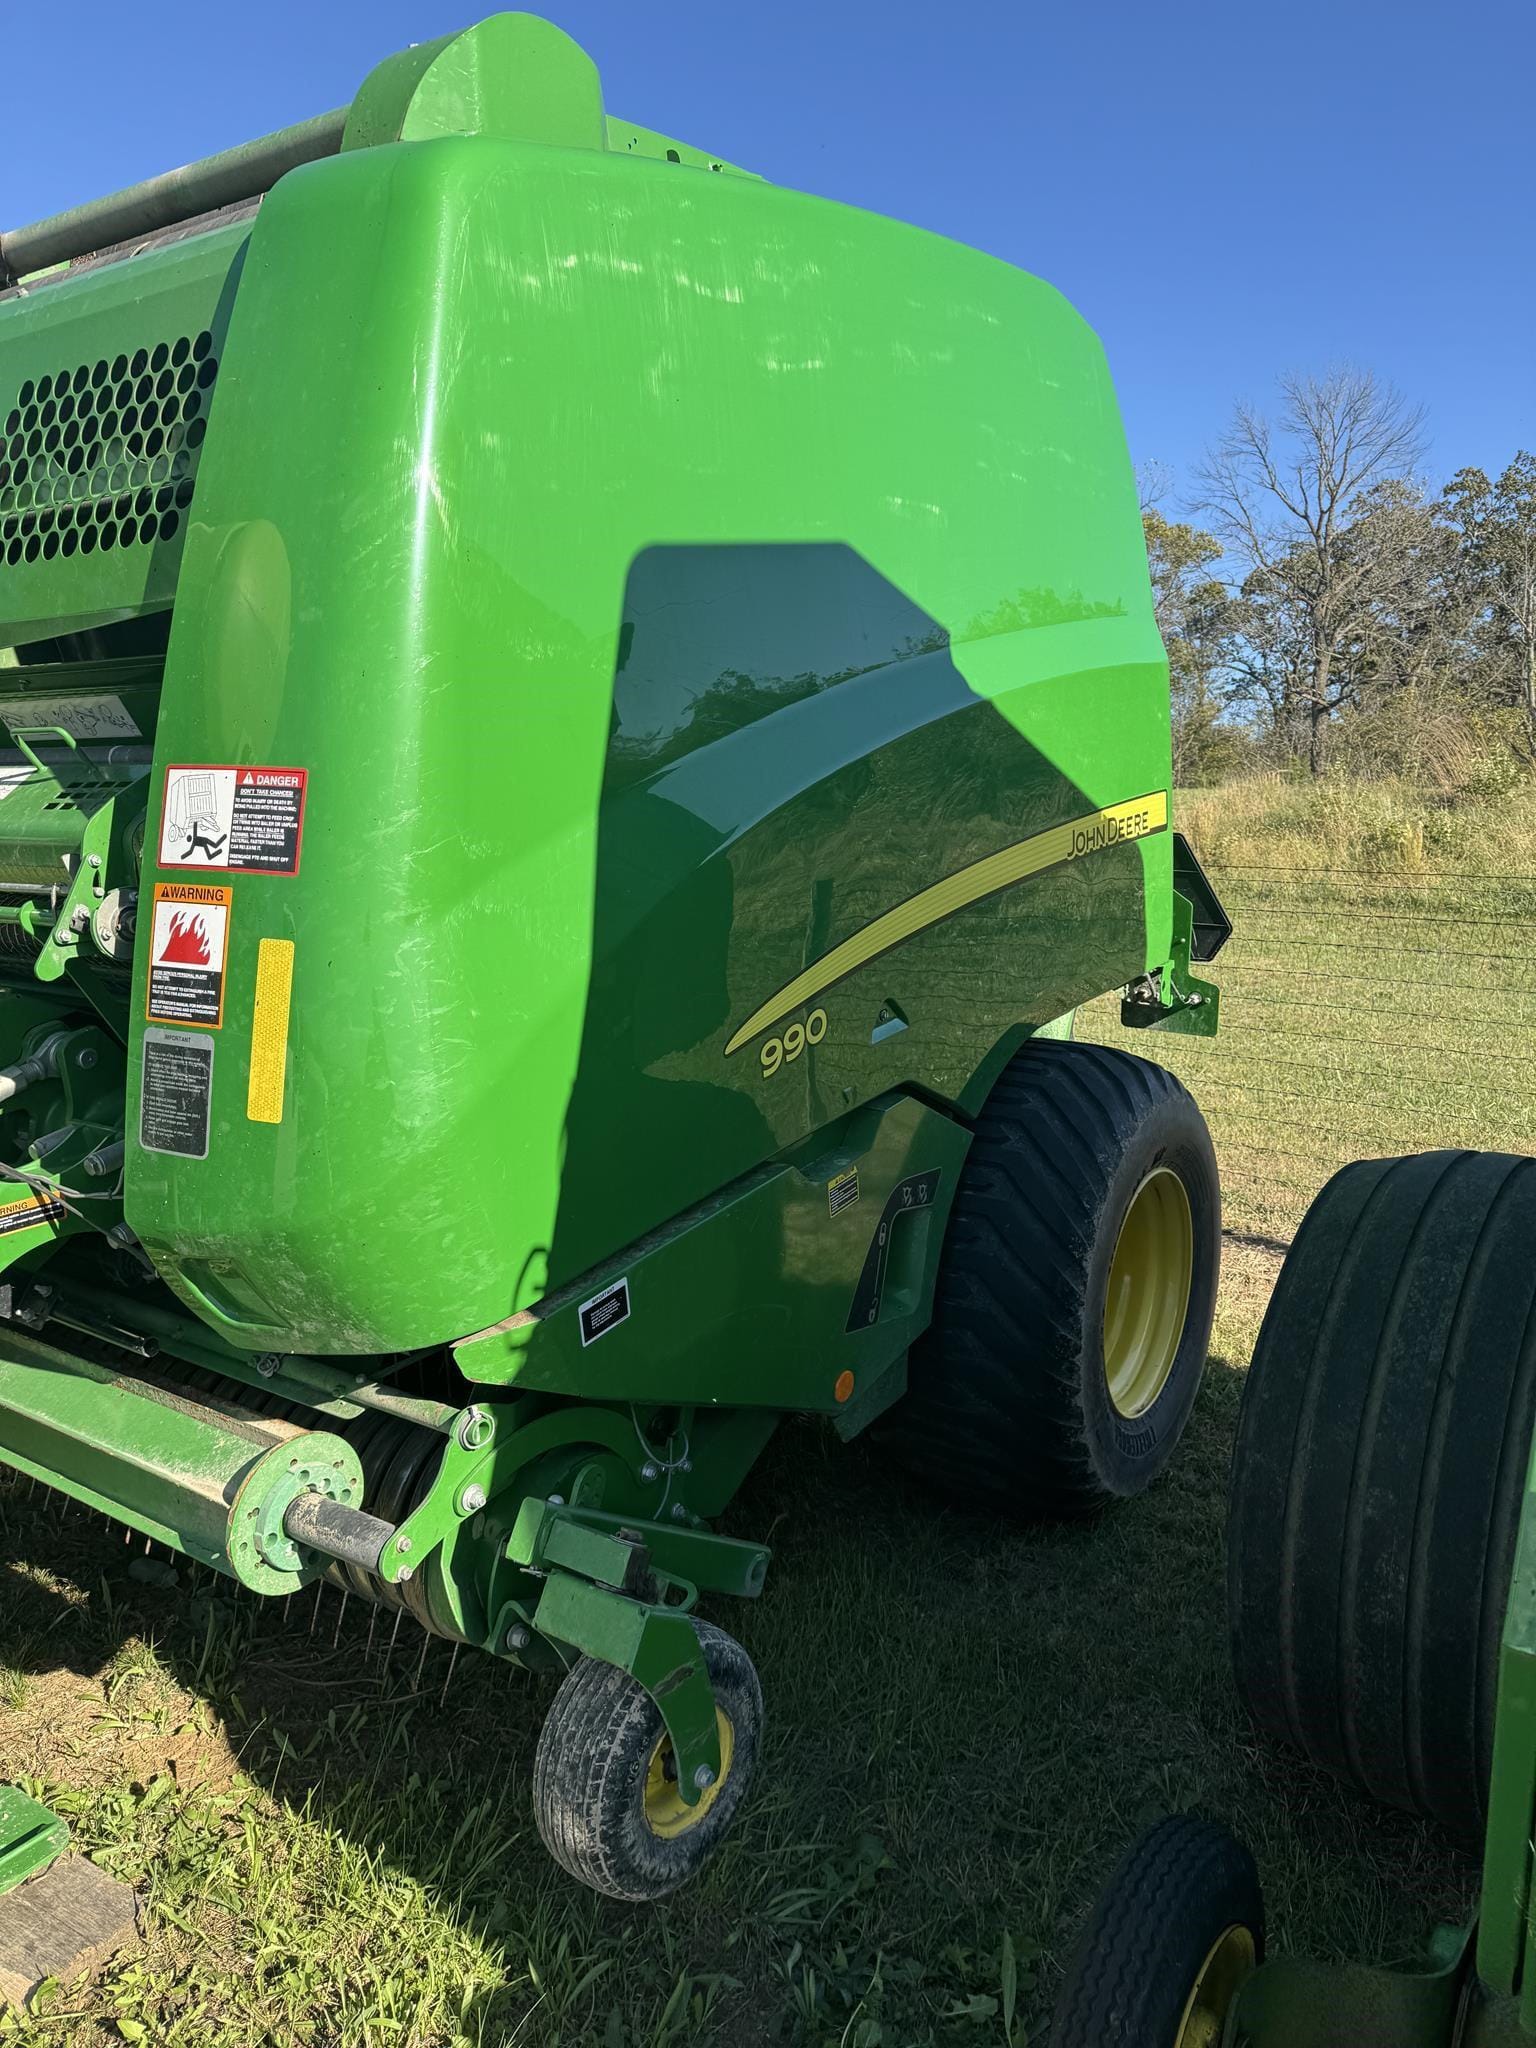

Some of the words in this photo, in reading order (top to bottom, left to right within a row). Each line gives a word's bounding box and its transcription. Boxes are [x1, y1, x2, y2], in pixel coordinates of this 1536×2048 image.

[256, 775, 298, 786] DANGER
[1067, 823, 1106, 857] JOHN
[1108, 811, 1148, 842] DEERE
[170, 886, 224, 901] WARNING
[164, 1034, 190, 1042] IMPORTANT
[760, 1008, 827, 1078] 990
[0, 1202, 28, 1214] RNING
[592, 1286, 615, 1304] IMPORTANT
